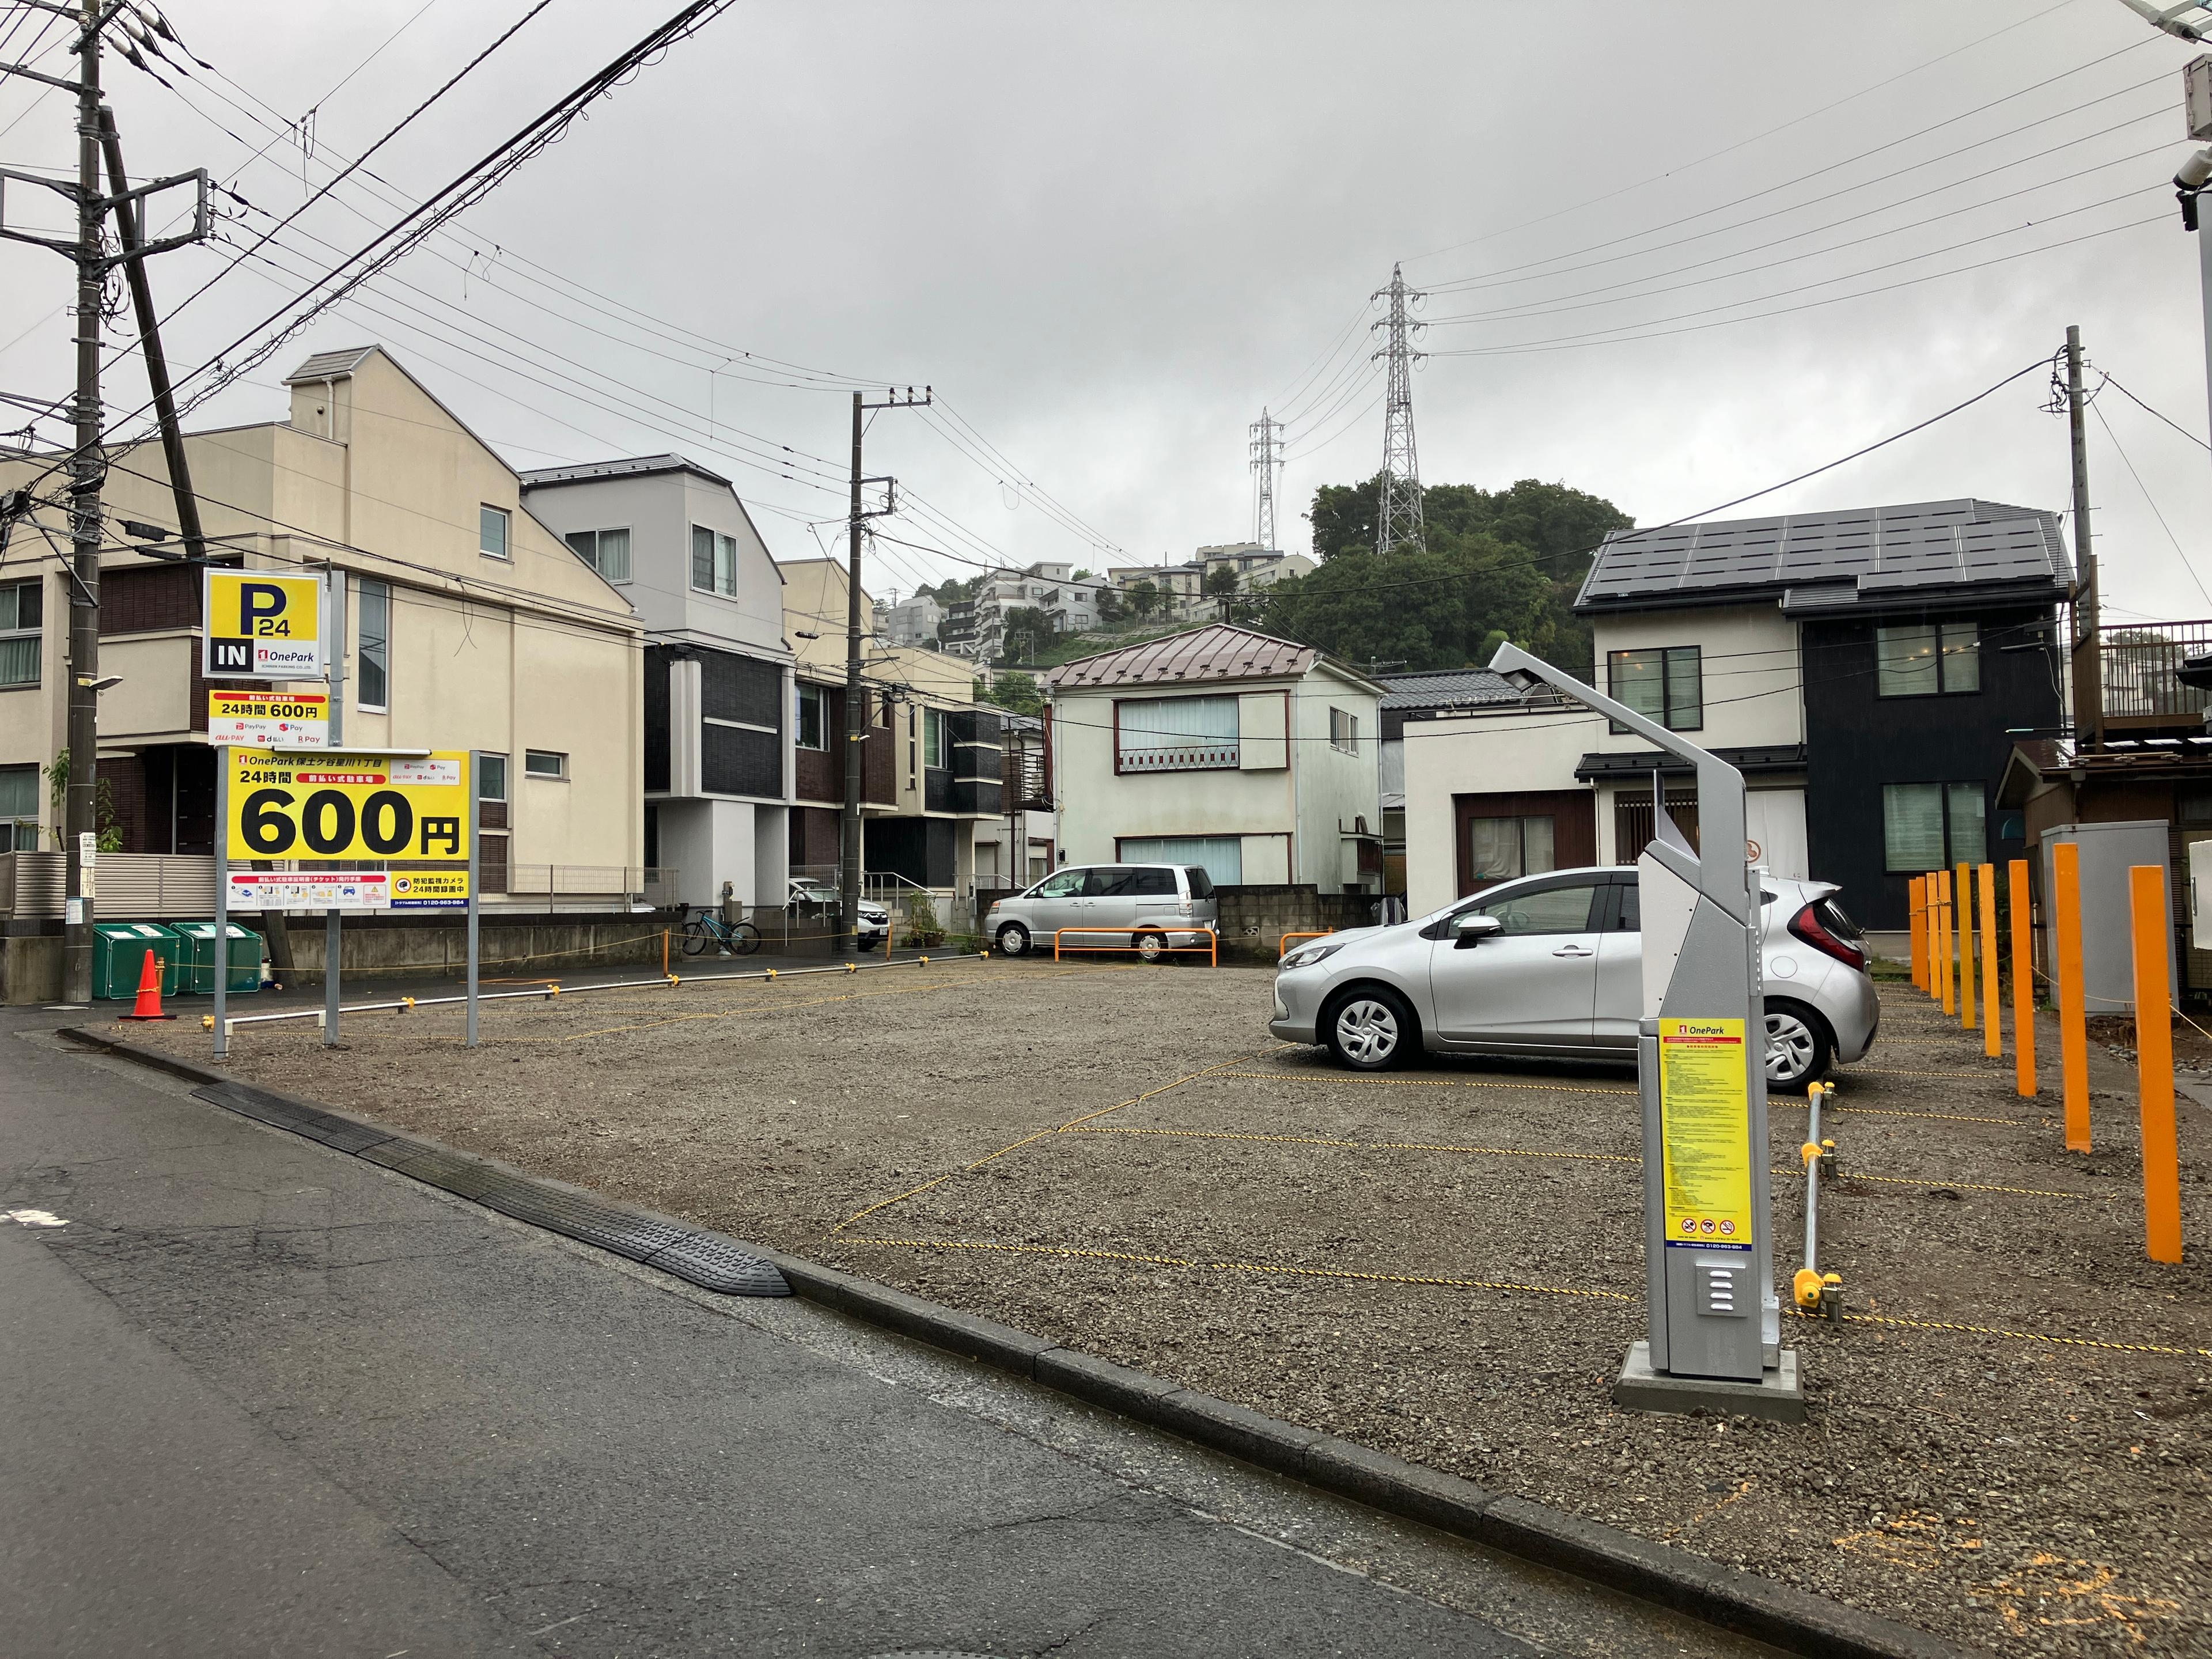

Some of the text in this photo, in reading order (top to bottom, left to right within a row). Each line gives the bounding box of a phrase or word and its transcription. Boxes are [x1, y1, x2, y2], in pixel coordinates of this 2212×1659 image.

[241, 583, 287, 635] P
[259, 619, 290, 637] 24
[218, 645, 246, 666] IN
[270, 652, 315, 662] OnePark
[222, 703, 317, 718] 24時間 600円
[249, 756, 294, 766] OnePark
[240, 770, 374, 784] 24時間 前払い式駐車場
[241, 789, 460, 855] 600円
[1690, 1026, 1724, 1035] OnePark
